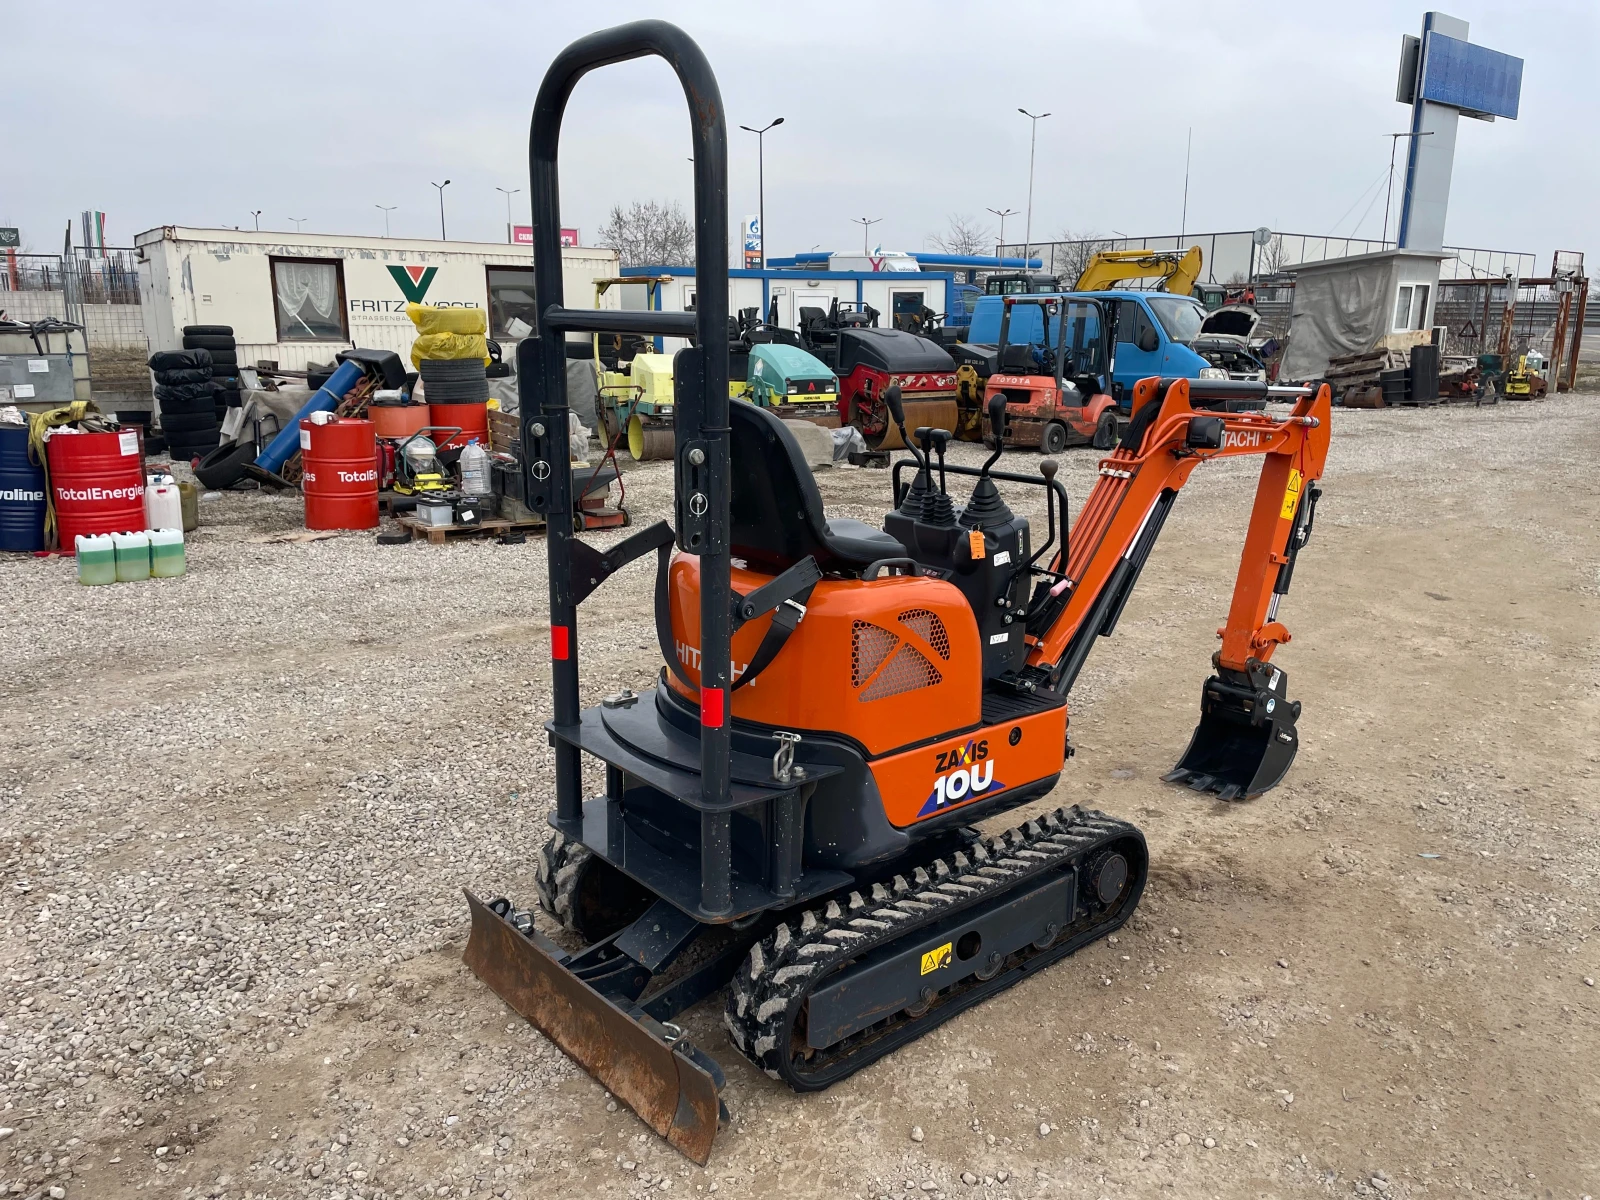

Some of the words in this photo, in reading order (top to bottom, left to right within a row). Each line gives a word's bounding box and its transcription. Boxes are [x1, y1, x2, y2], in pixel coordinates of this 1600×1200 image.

[350, 300, 406, 312] FRITZ
[996, 376, 1030, 385] TOYOTA
[1224, 430, 1260, 447] TACHI
[935, 740, 988, 774] ZAXIS
[934, 759, 994, 806] 10U
